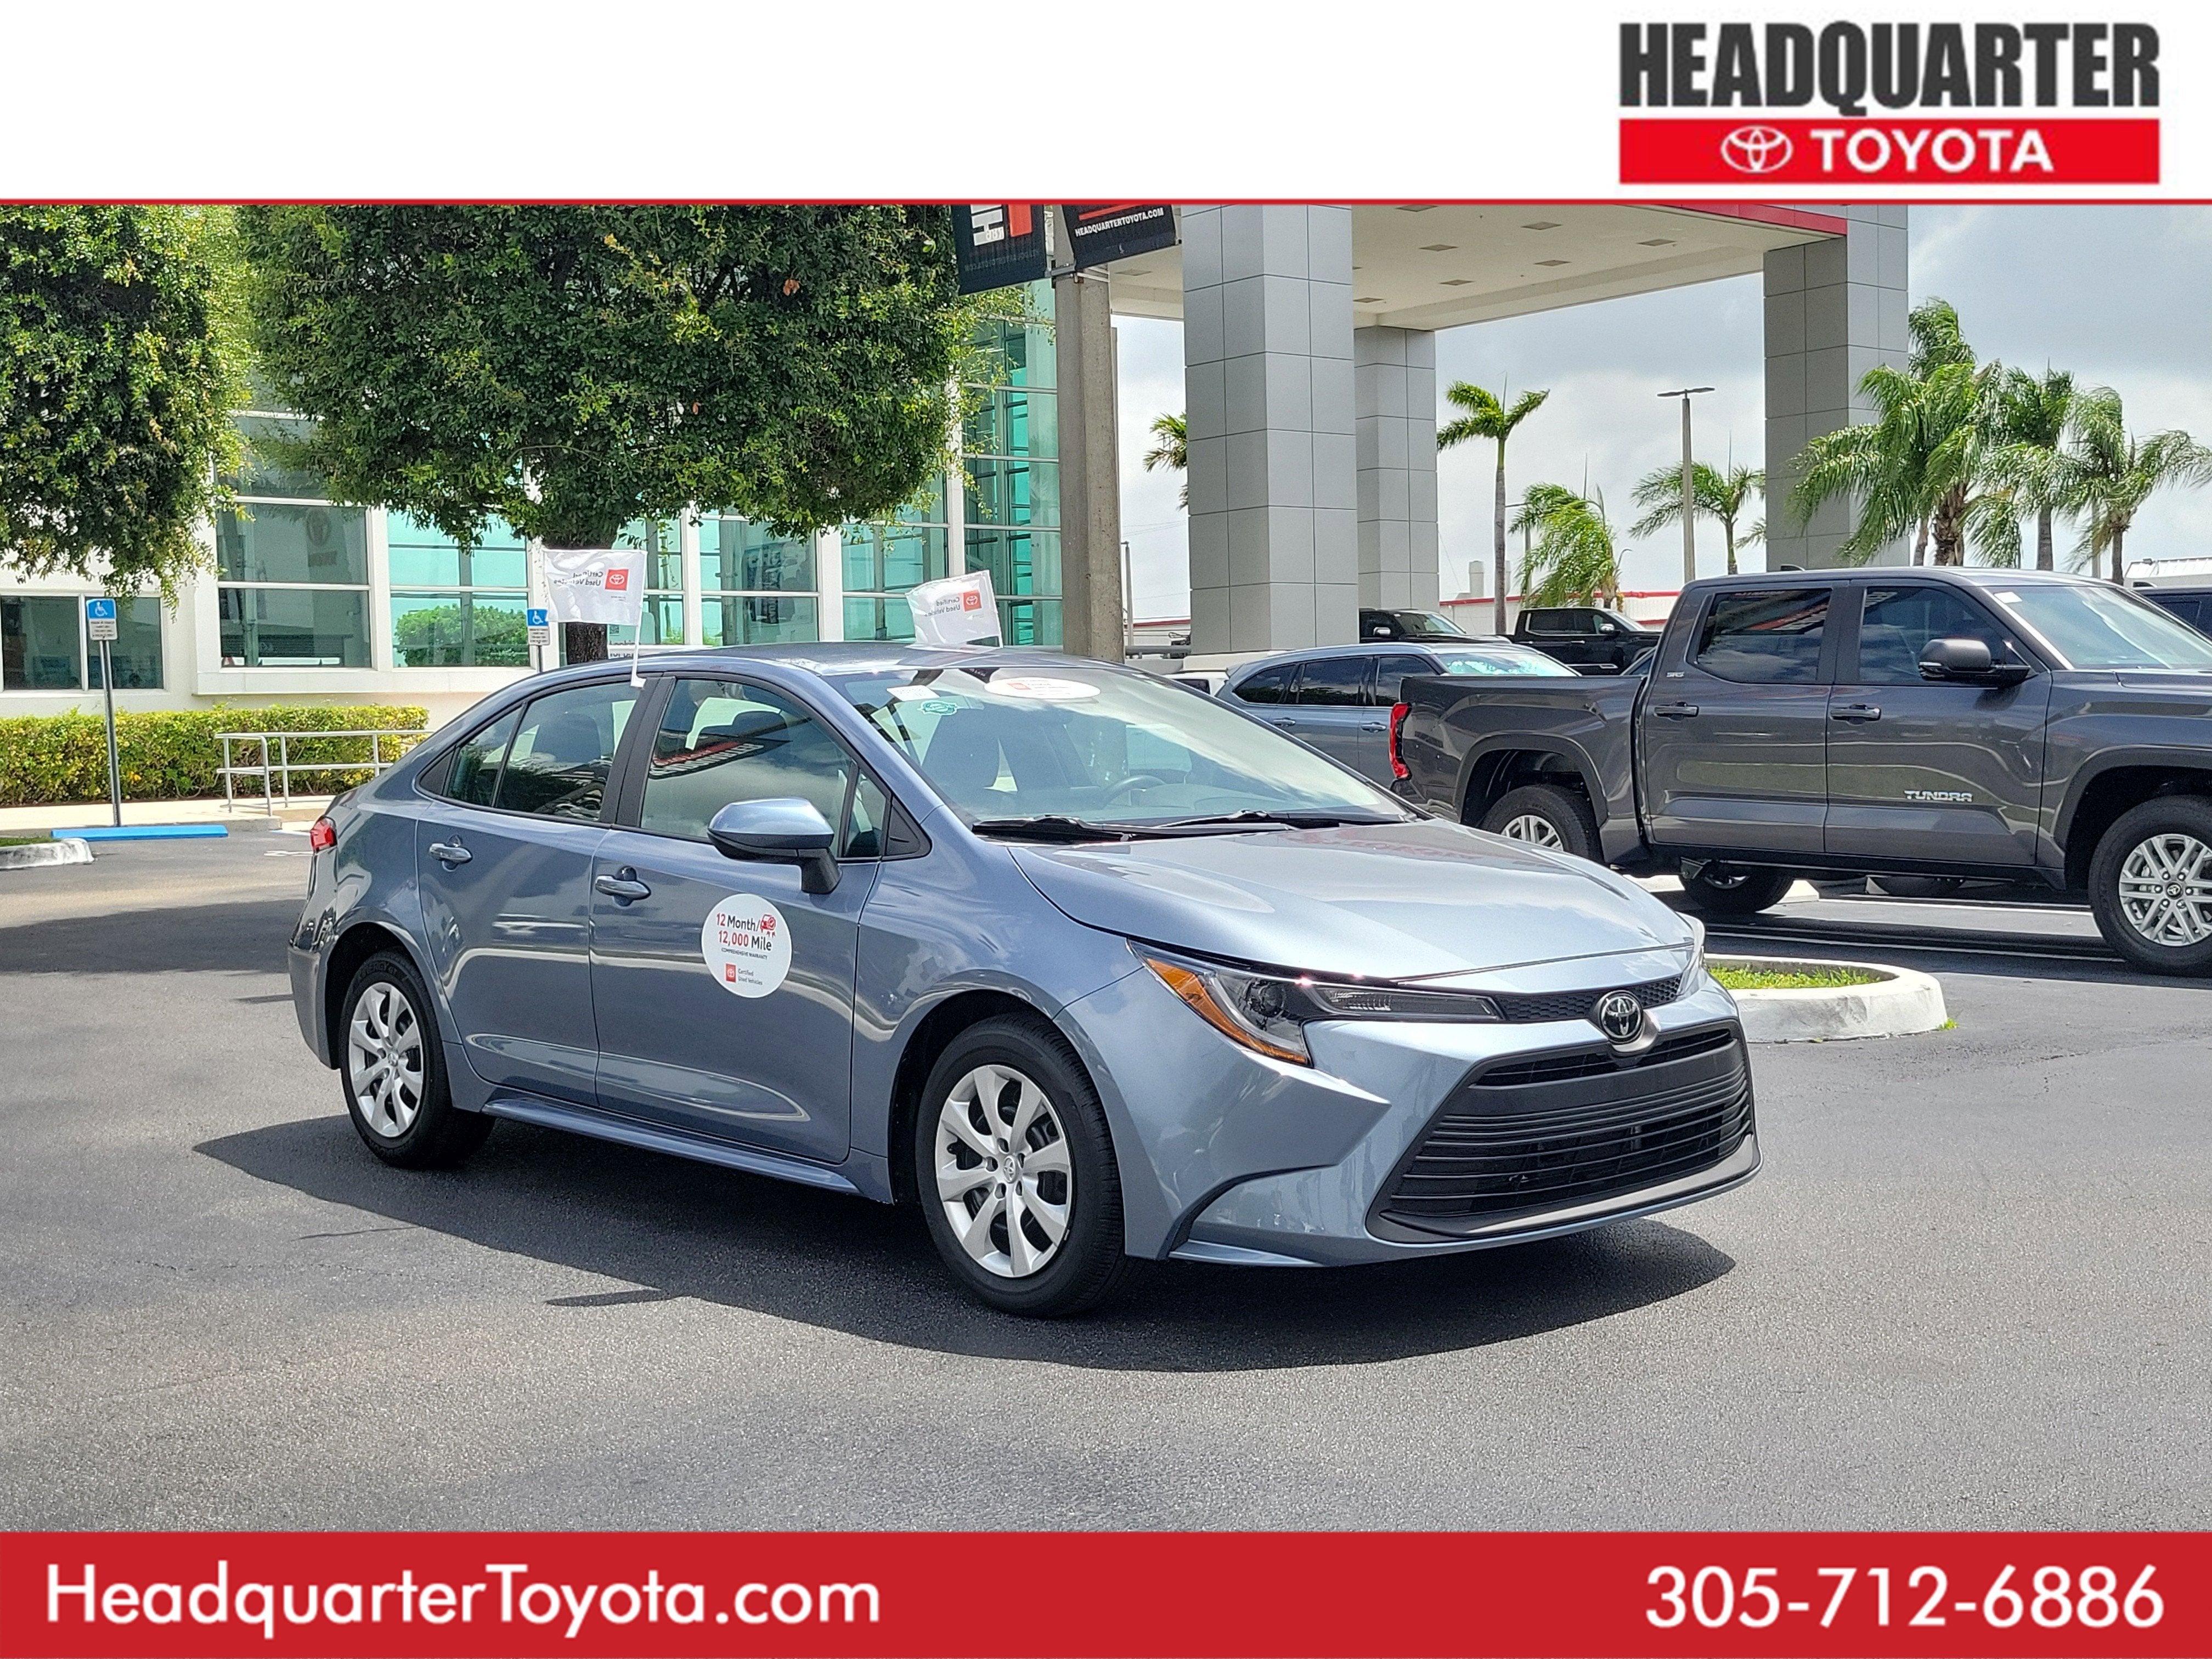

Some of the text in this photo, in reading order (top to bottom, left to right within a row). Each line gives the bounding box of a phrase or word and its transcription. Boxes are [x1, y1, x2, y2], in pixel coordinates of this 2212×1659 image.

[1075, 208, 1164, 238] HEADQUARTERTOYOTA.COM
[1904, 790, 1972, 802] TUNDRA
[716, 913, 725, 927] 12
[718, 930, 772, 951] 12,000 Mile
